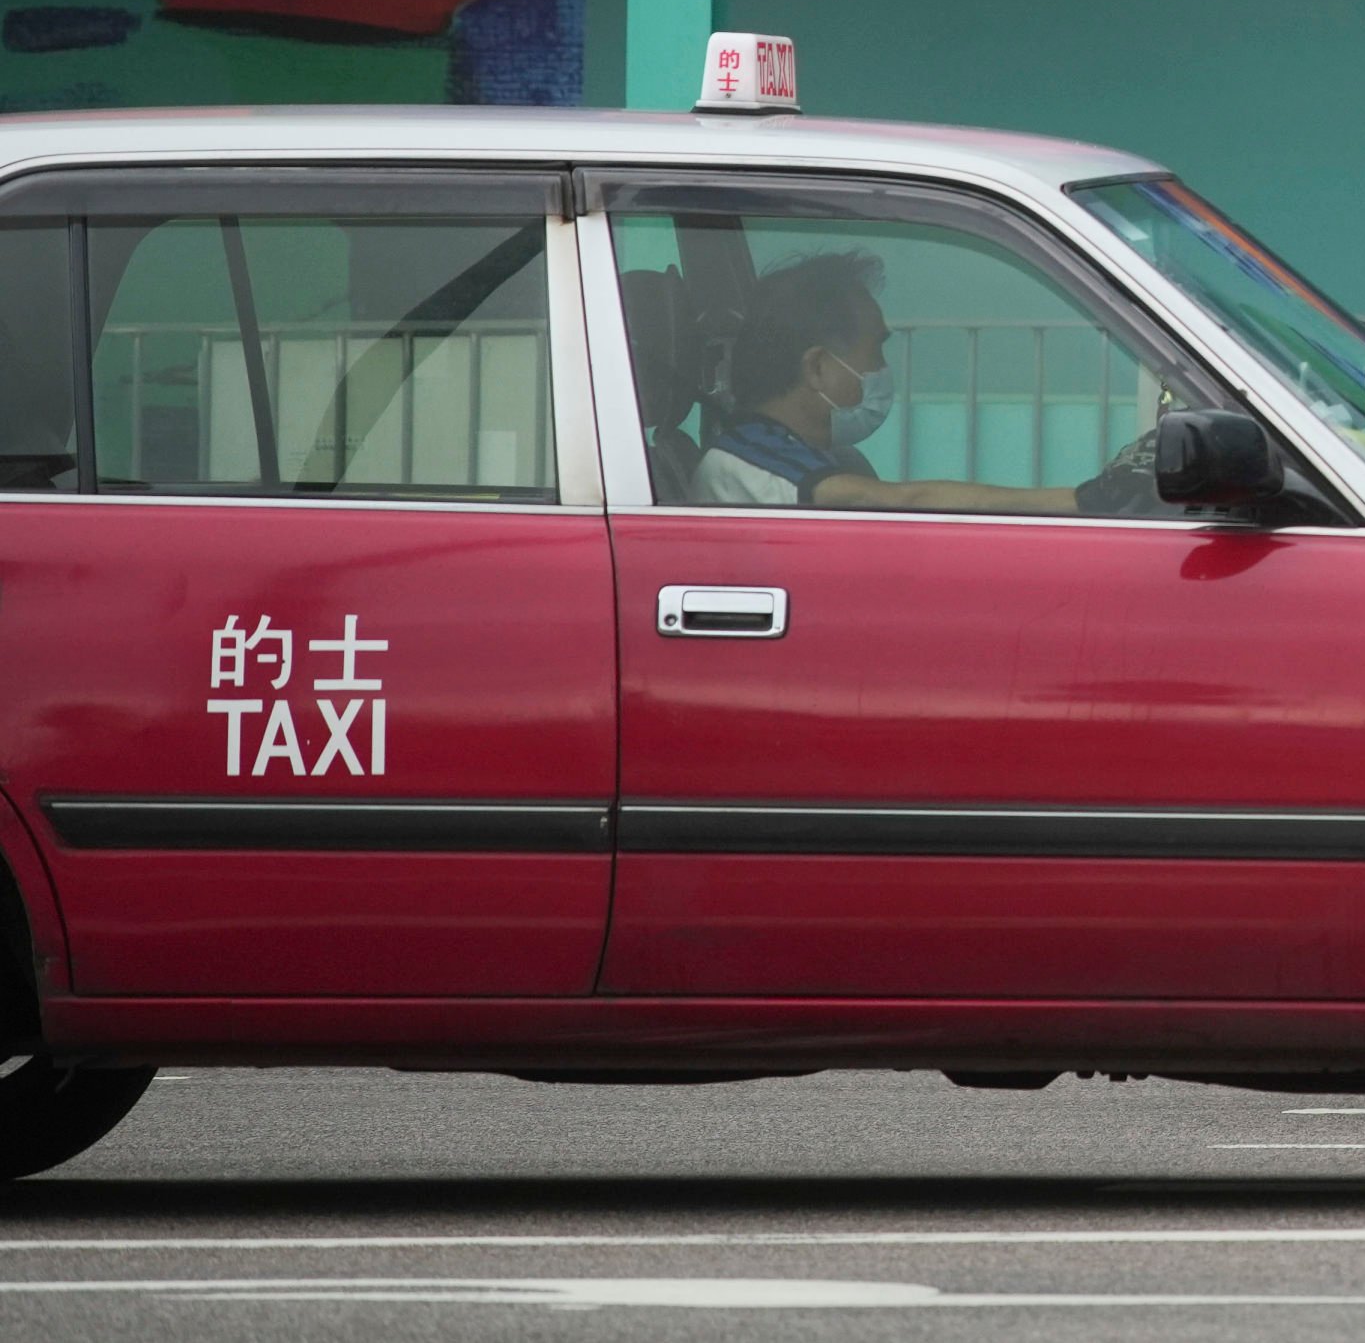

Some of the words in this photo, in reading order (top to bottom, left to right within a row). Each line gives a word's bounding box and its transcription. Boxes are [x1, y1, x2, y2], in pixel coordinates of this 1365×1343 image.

[717, 50, 740, 92] 的士
[757, 42, 794, 98] TAXI
[210, 614, 389, 691] 的士
[206, 699, 387, 776] TAXI
